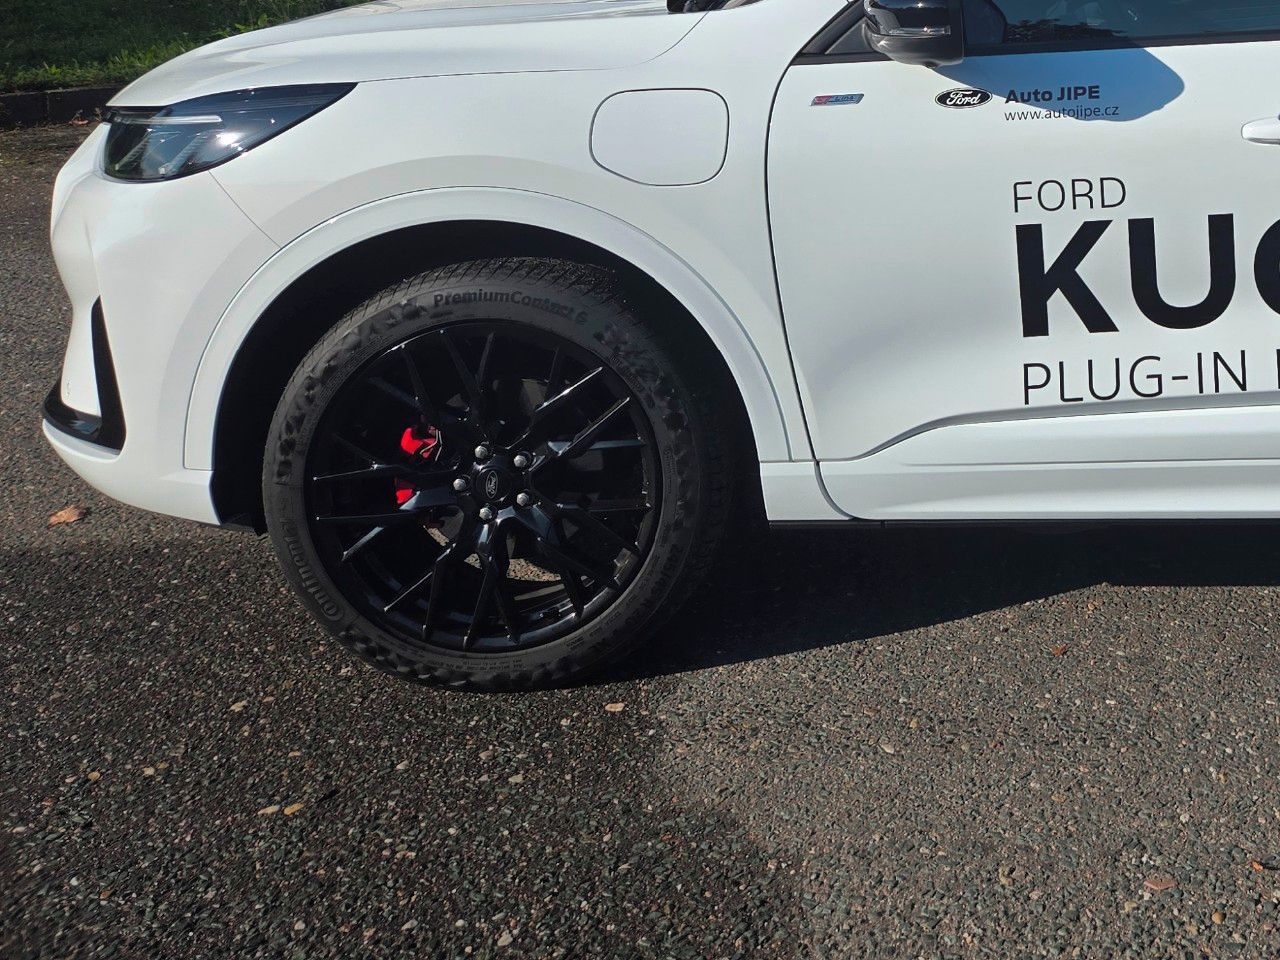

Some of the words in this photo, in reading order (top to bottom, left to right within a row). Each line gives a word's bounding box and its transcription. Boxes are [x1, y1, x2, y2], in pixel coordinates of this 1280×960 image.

[946, 90, 980, 106] Ford
[1004, 89, 1053, 104] Auto
[1057, 85, 1100, 101] JIPE
[1004, 104, 1119, 121] www.autojipe.cz
[1013, 176, 1127, 213] FORD
[1022, 349, 1248, 406] PLUG-IN
